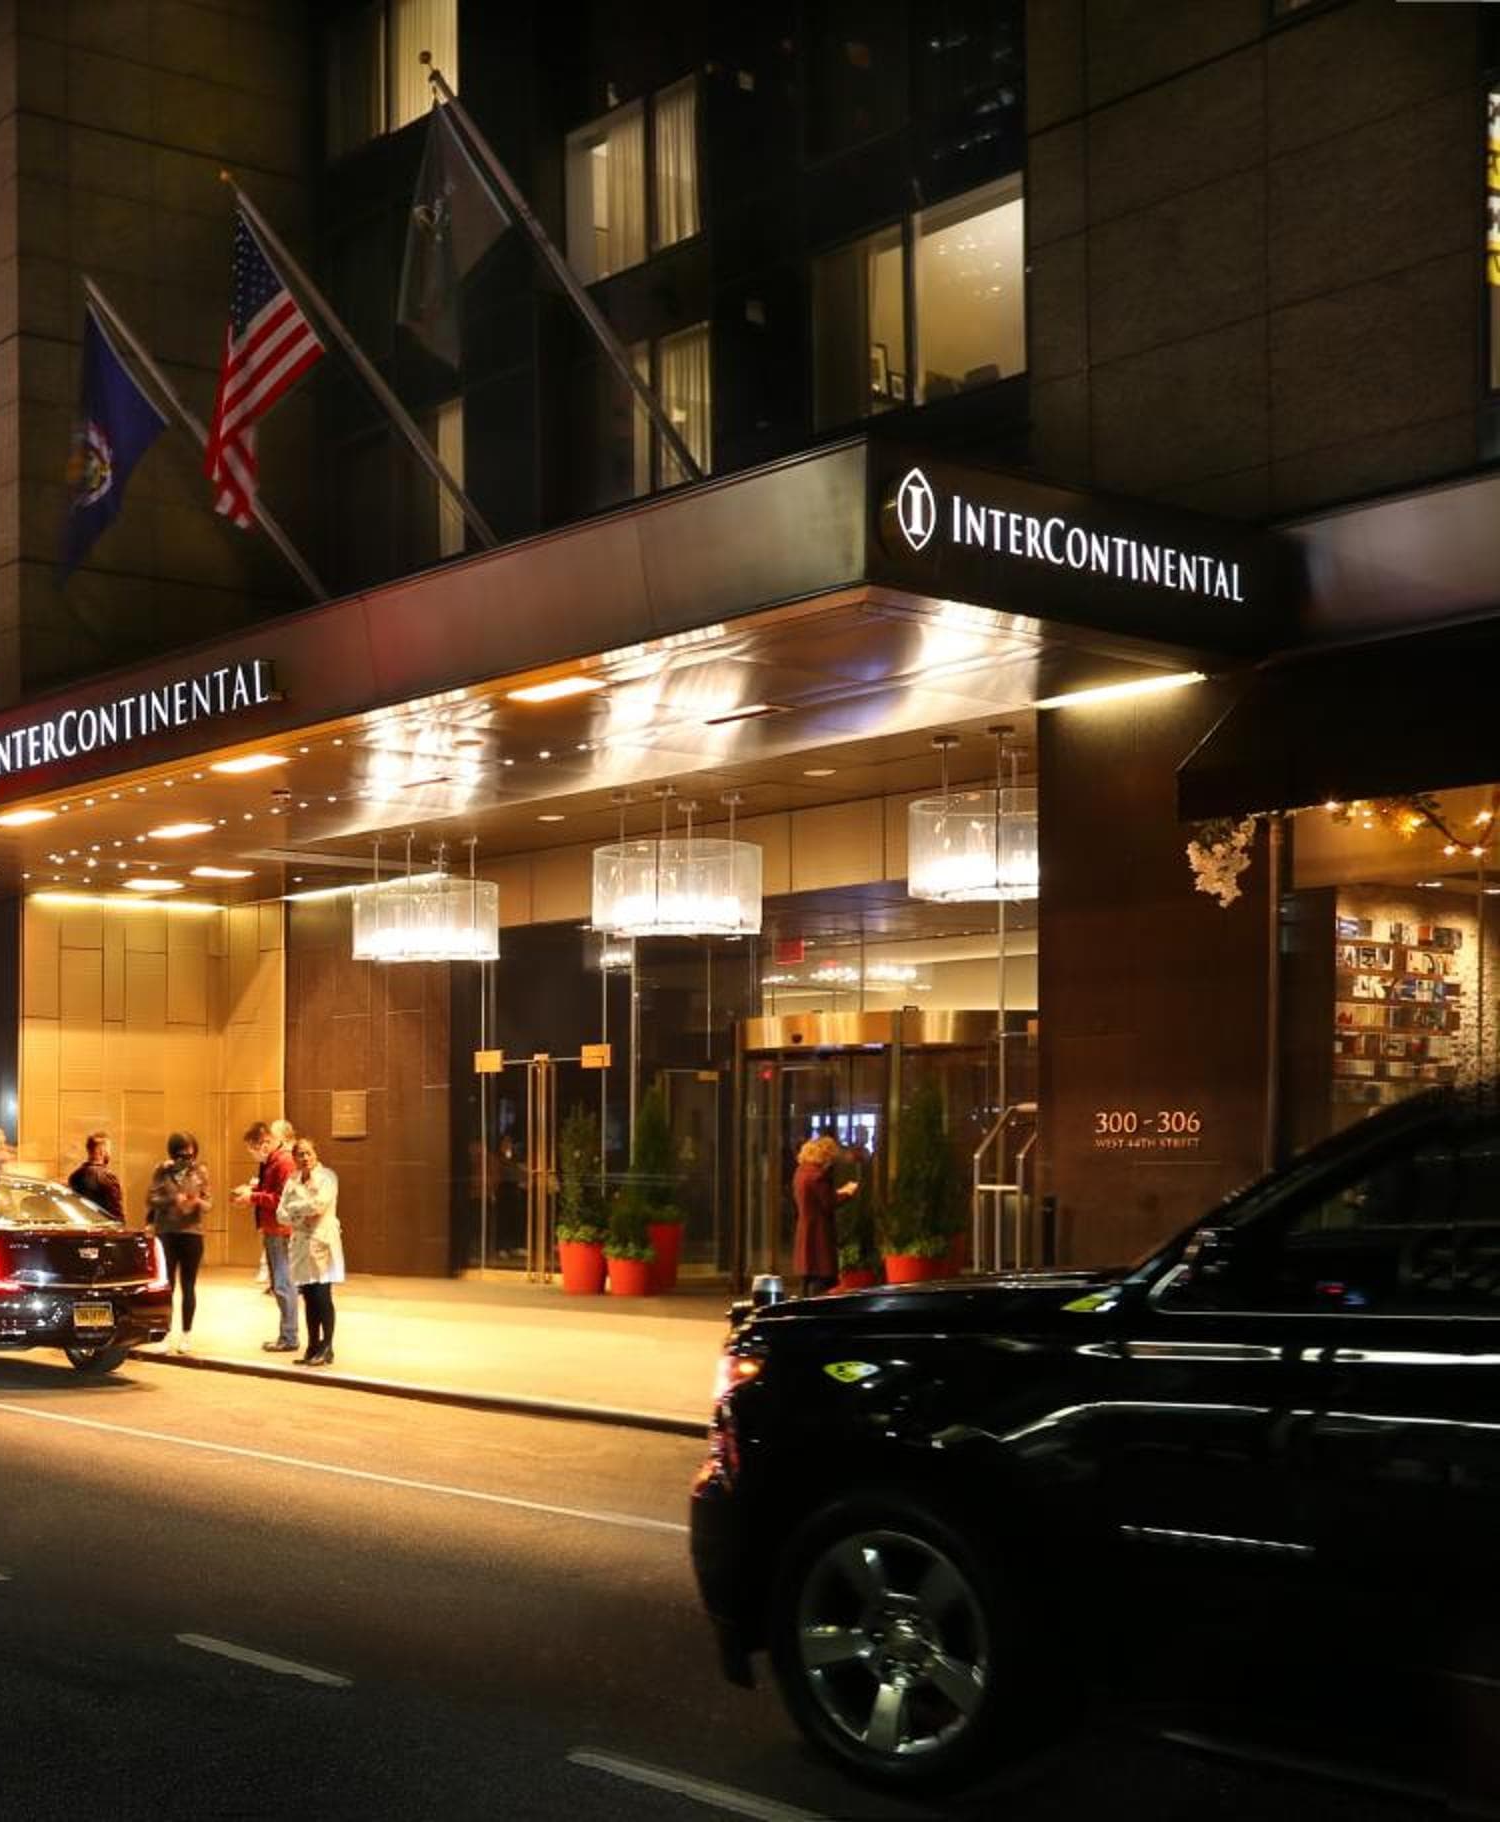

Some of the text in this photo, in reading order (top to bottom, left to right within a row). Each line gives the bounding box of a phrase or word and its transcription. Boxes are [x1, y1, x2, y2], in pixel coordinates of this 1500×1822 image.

[1095, 1111, 1138, 1133] 300
[1157, 1111, 1201, 1133] 306
[1095, 1138, 1125, 1148] WEST
[1158, 1137, 1200, 1149] STREET
